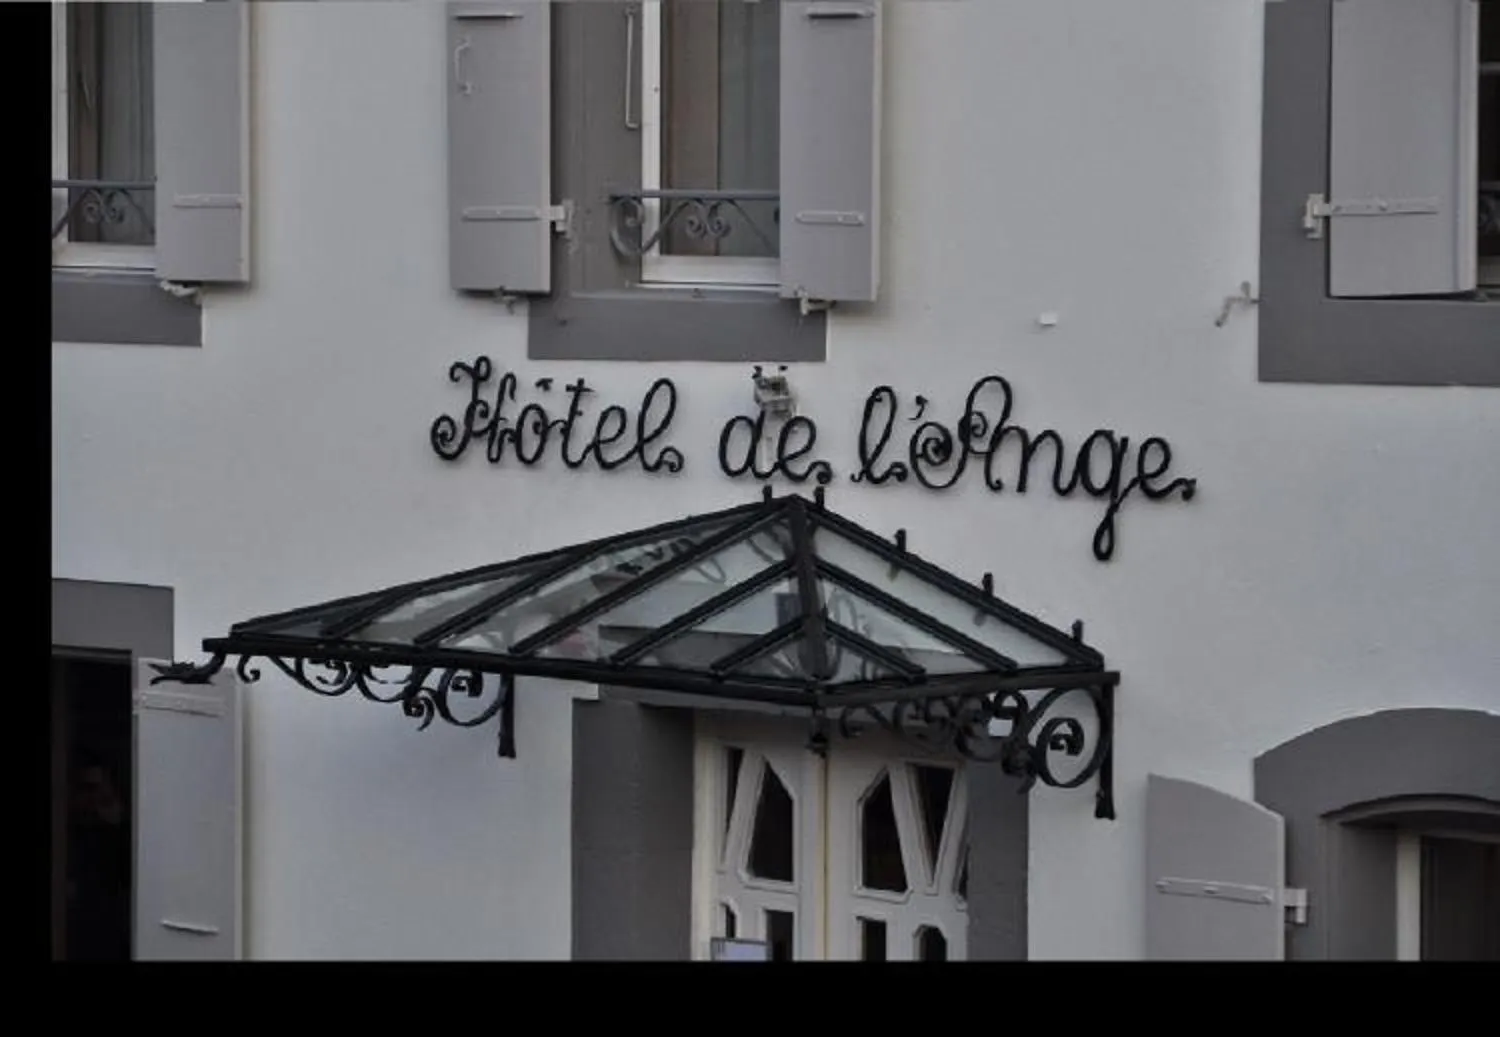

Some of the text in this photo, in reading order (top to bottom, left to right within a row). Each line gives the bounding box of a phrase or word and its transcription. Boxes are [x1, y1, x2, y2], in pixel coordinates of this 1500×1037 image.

[431, 356, 1197, 561] Hôtel de l'Ange
